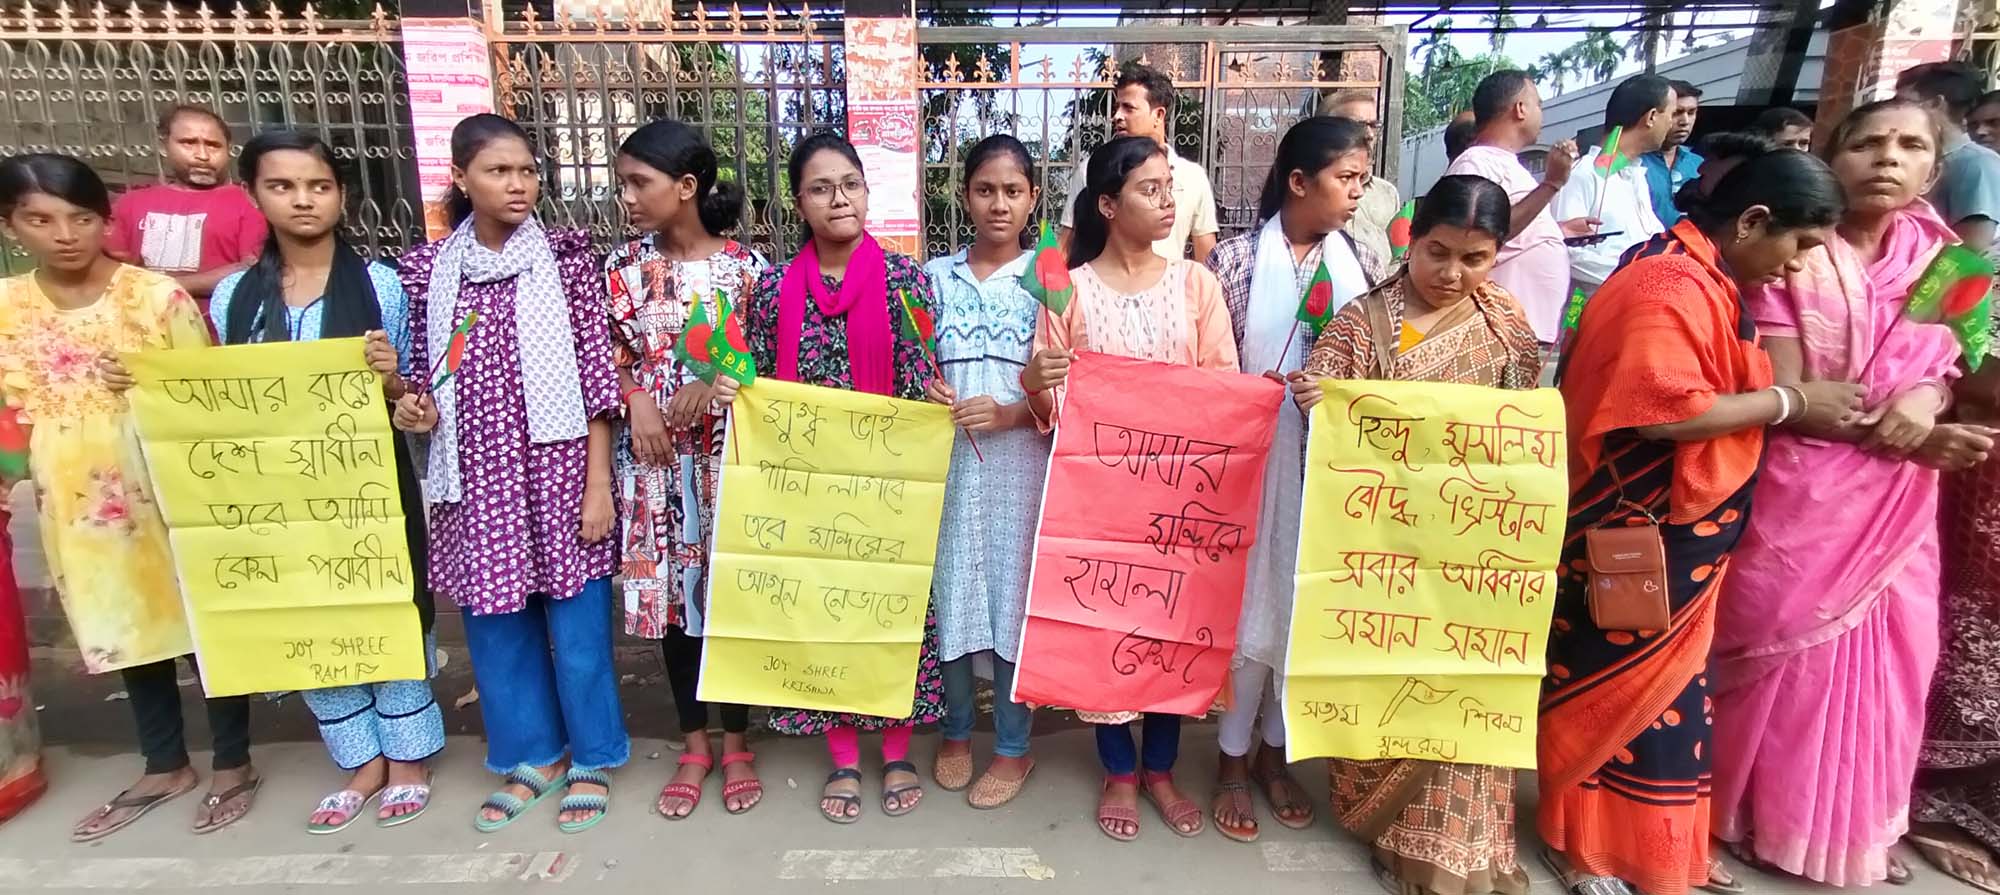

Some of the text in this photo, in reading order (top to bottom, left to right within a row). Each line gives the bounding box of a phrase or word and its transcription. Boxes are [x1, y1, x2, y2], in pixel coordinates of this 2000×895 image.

[157, 377, 287, 414] আমার
[179, 413, 384, 480] দেশ স্বাধীন
[763, 398, 918, 457] মুগ্ধ ভাই
[1444, 404, 1563, 485] মুসলিম
[759, 456, 906, 515] পানি লাগবে
[1093, 421, 1238, 494] আমার
[205, 482, 392, 536] তবে আমি
[741, 511, 905, 564] তবে মন্দিরের
[1145, 500, 1247, 565] মন্দিরে
[214, 533, 405, 591] কেন পরাধীন
[1063, 555, 1187, 620] হামলা
[1329, 548, 1546, 608] সবার অধিকার
[735, 568, 802, 620] আগুন
[283, 635, 393, 661] JOY SHREE
[1320, 607, 1533, 668] সমান সমান
[310, 662, 349, 684] RAM
[763, 655, 849, 681] JOY SHREE
